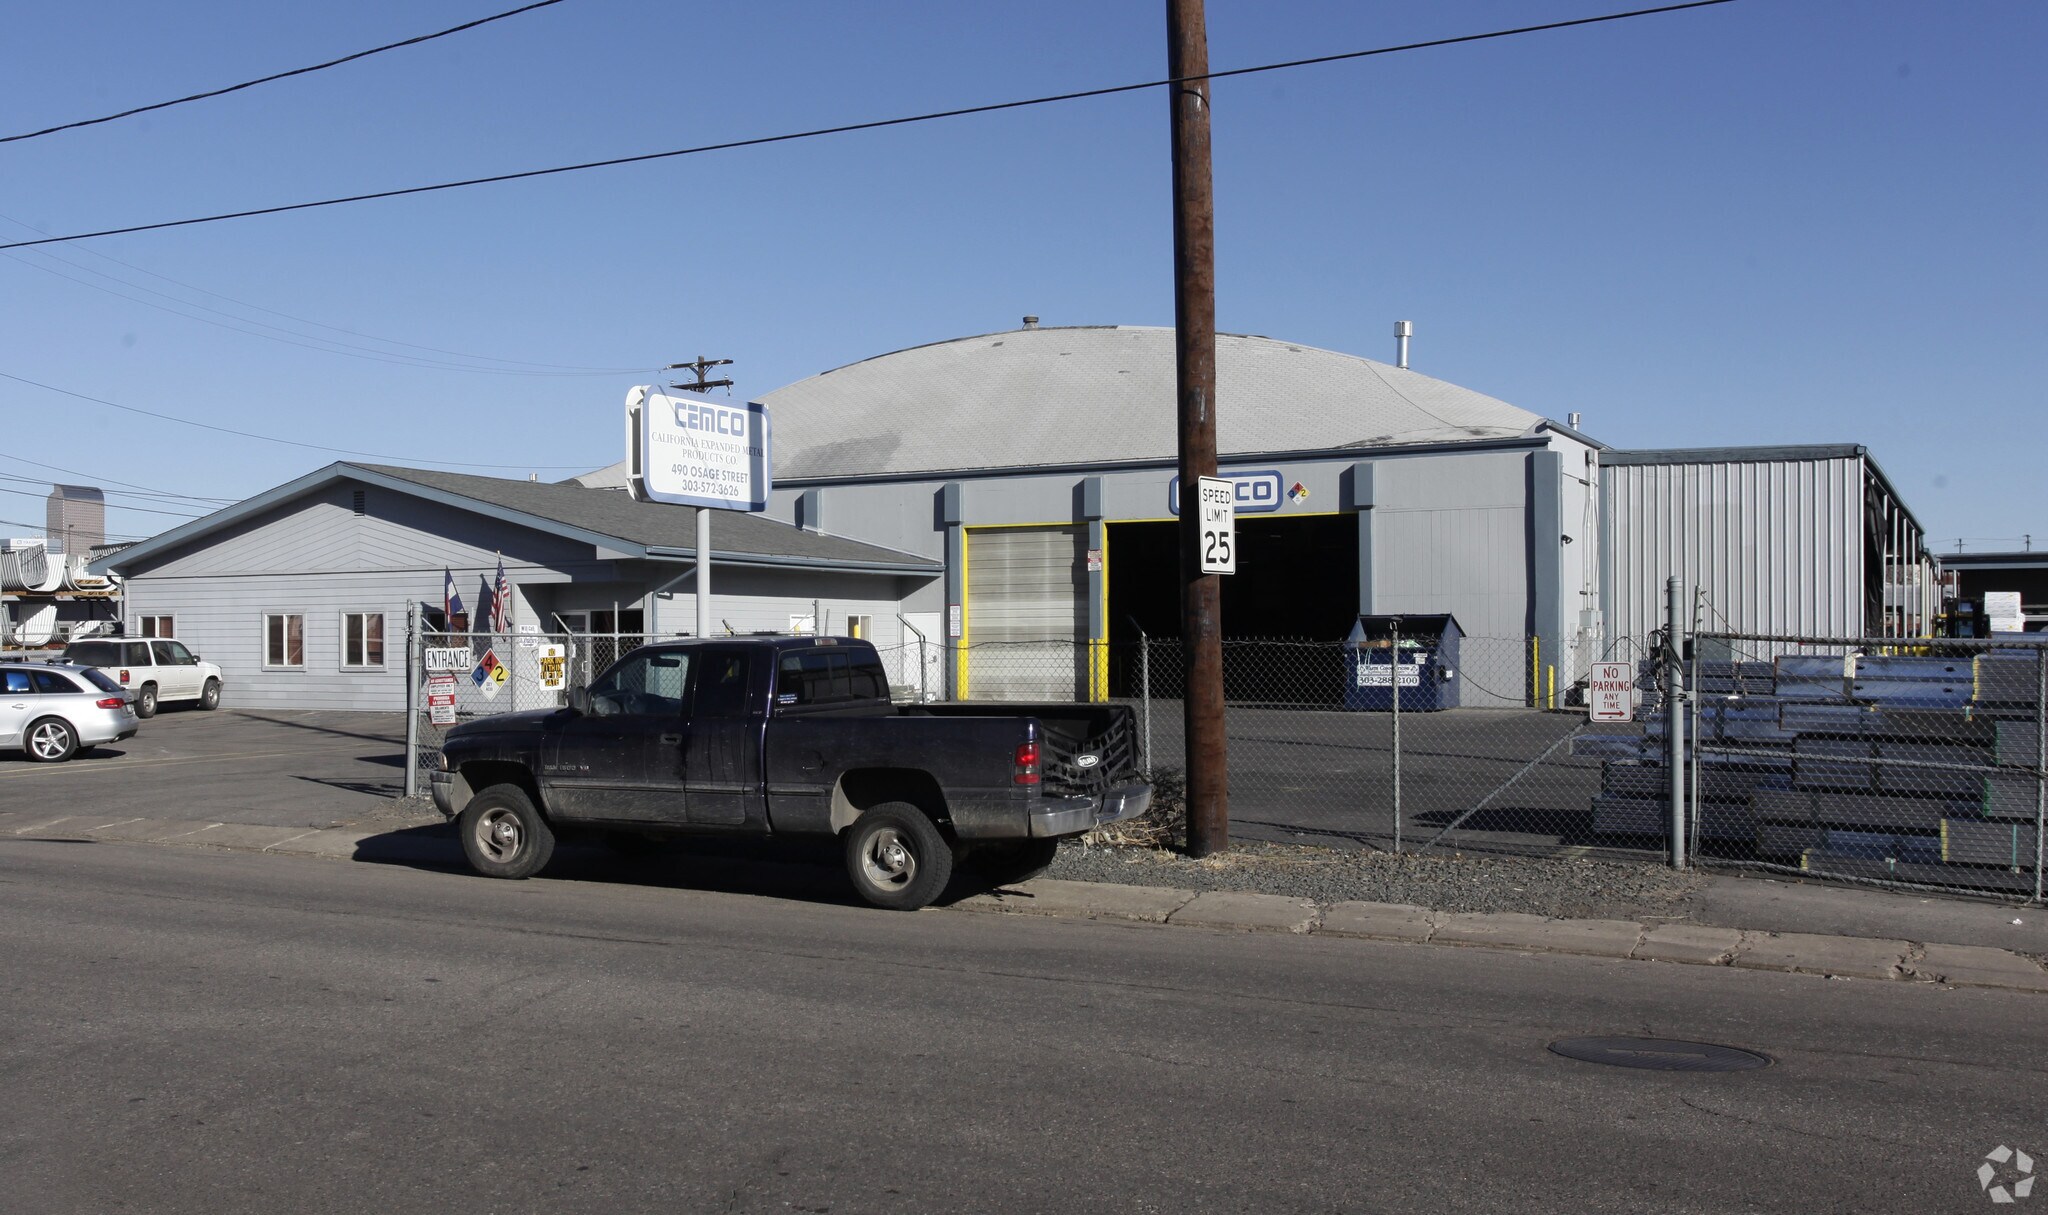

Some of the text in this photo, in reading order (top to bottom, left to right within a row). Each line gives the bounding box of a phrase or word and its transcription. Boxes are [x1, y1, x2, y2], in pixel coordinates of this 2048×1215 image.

[674, 401, 744, 437] CEMCO
[651, 431, 765, 458] CALIFORNIA EXPANDED METAL
[682, 448, 738, 466] PRODUCTS CO.
[671, 463, 748, 484] 490 OSAGE STREET
[681, 479, 739, 497] 303-572-3626
[1202, 488, 1231, 505] SPEED
[1301, 489, 1307, 497] 2
[1206, 508, 1228, 523] LIMIT
[1204, 530, 1231, 564] 25
[427, 650, 470, 669] ENTRANCE
[484, 654, 493, 670] 4
[476, 666, 484, 682] 3
[495, 665, 504, 682] 2
[1603, 667, 1619, 679] NO
[1593, 681, 1630, 692] PARKING
[1603, 701, 1620, 709] TIME
